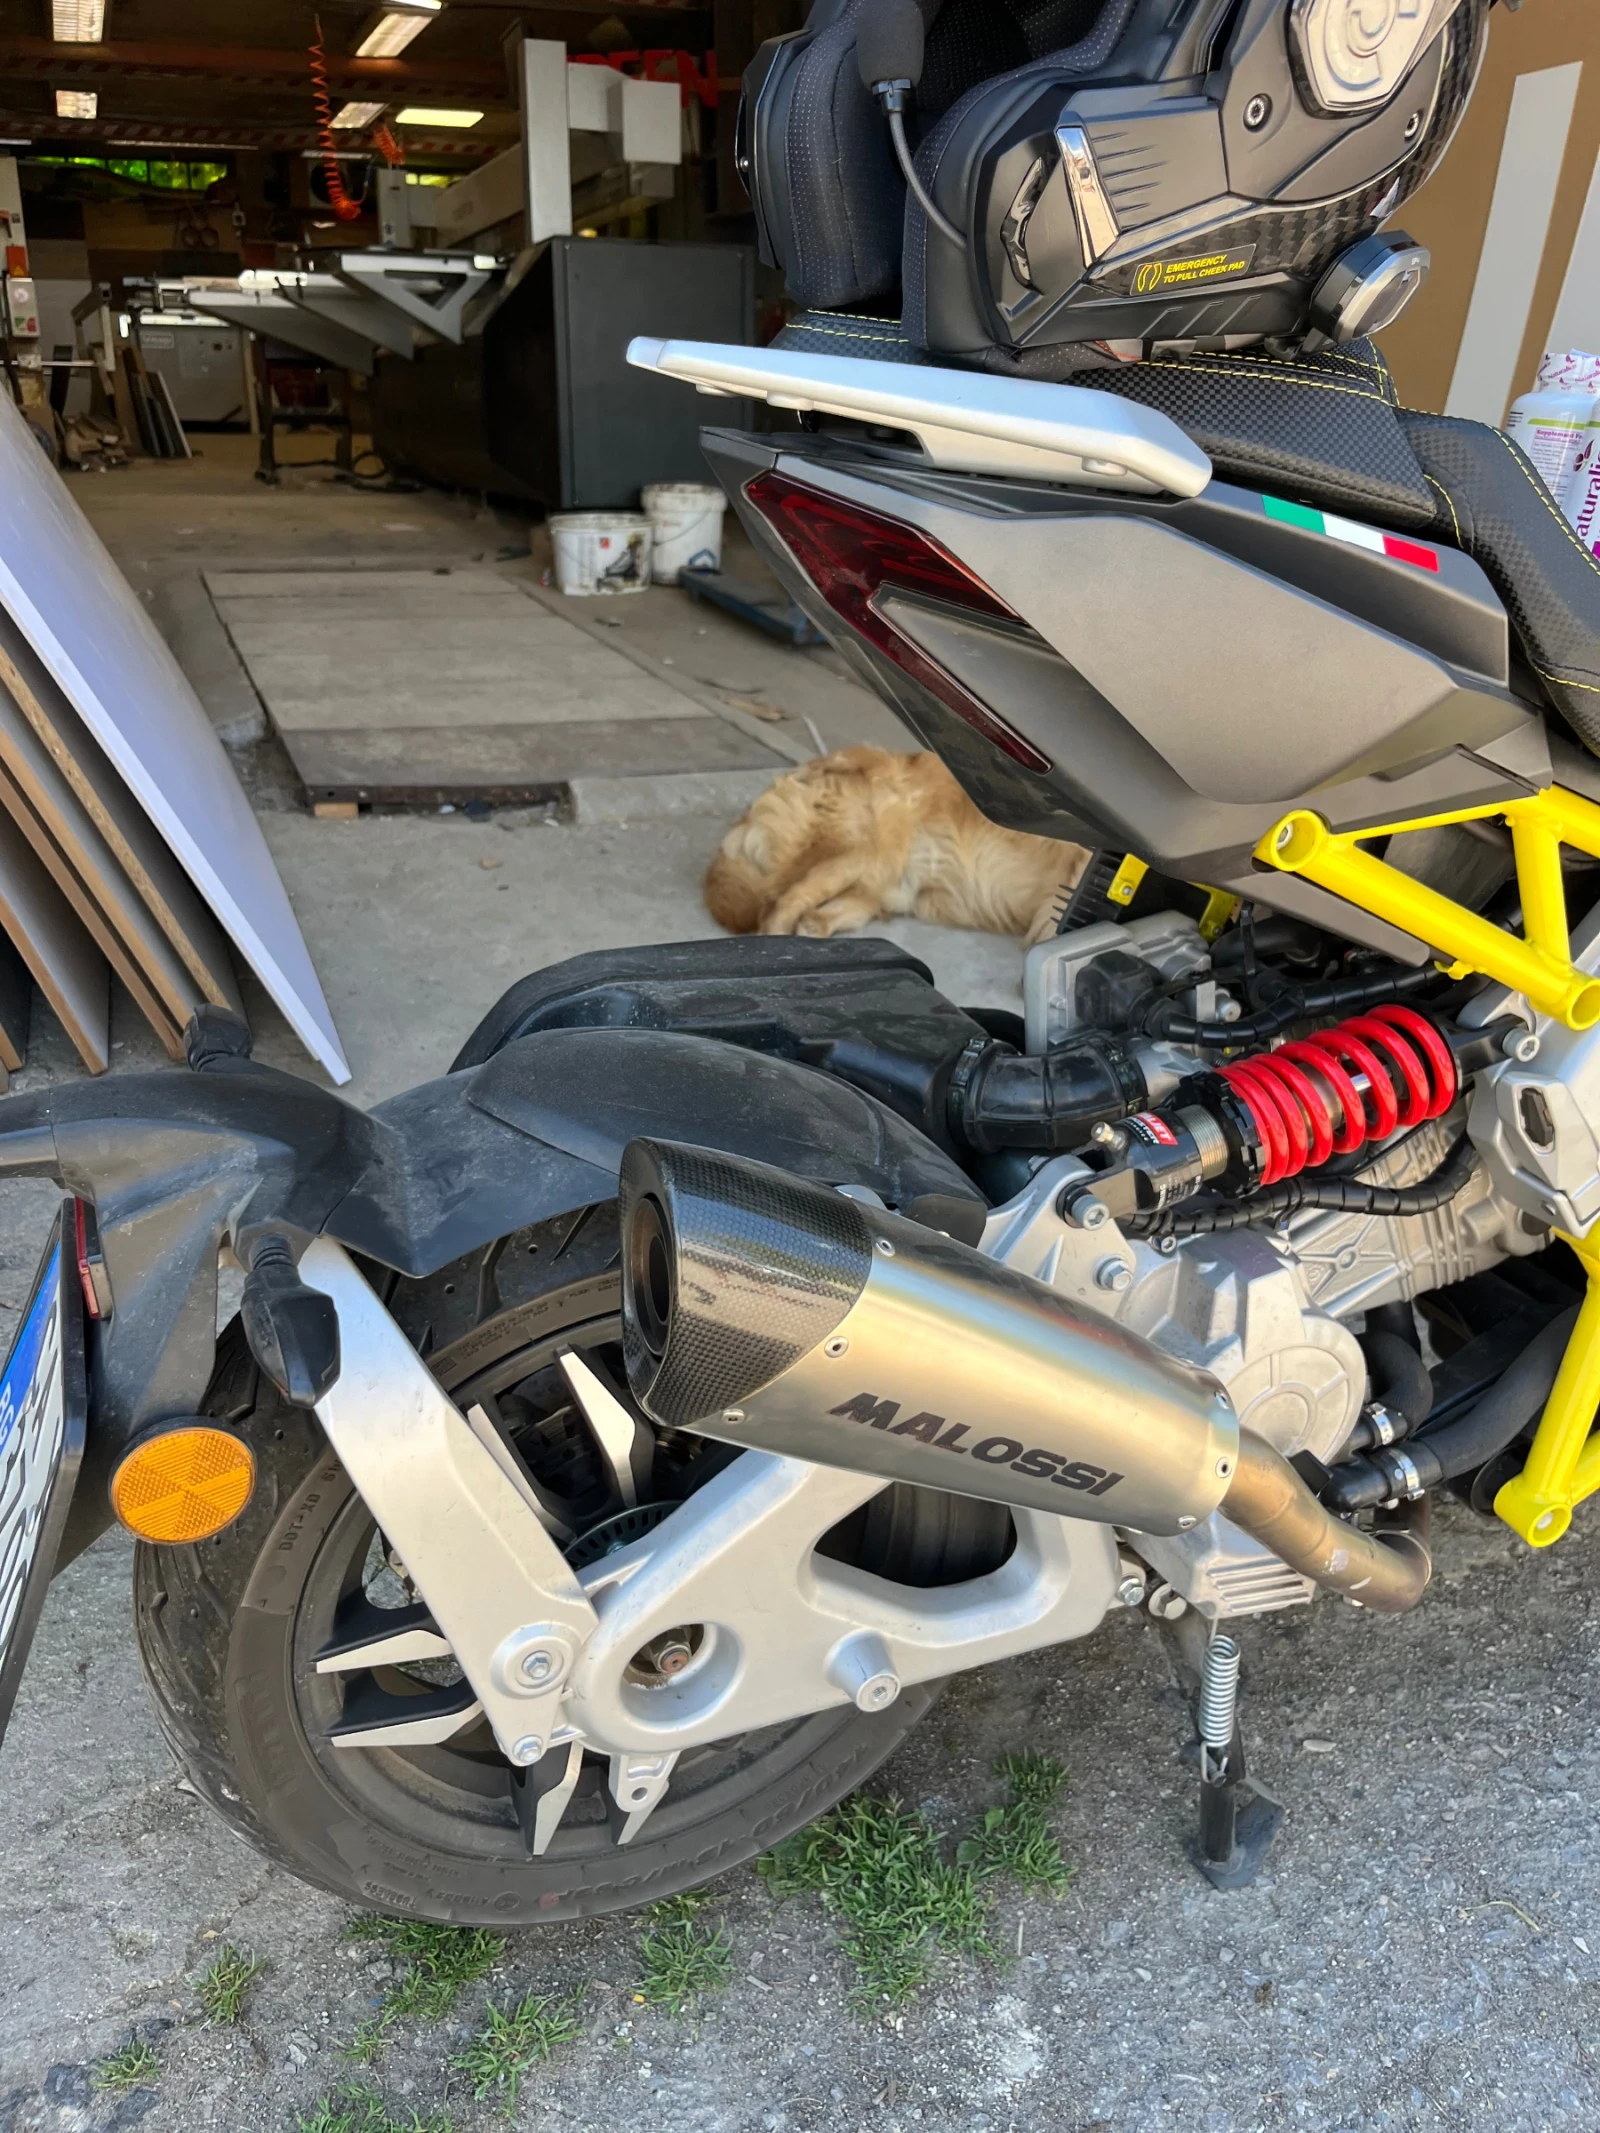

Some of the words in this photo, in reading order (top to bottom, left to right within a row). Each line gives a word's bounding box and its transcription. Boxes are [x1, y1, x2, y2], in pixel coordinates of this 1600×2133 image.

[1163, 275, 1175, 284] TO
[1176, 271, 1197, 281] PULL
[1199, 265, 1228, 277] CHEEK
[1228, 261, 1245, 271] PAD
[1166, 254, 1227, 273] EMERGENCY
[825, 1392, 1125, 1497] MALOSSI
